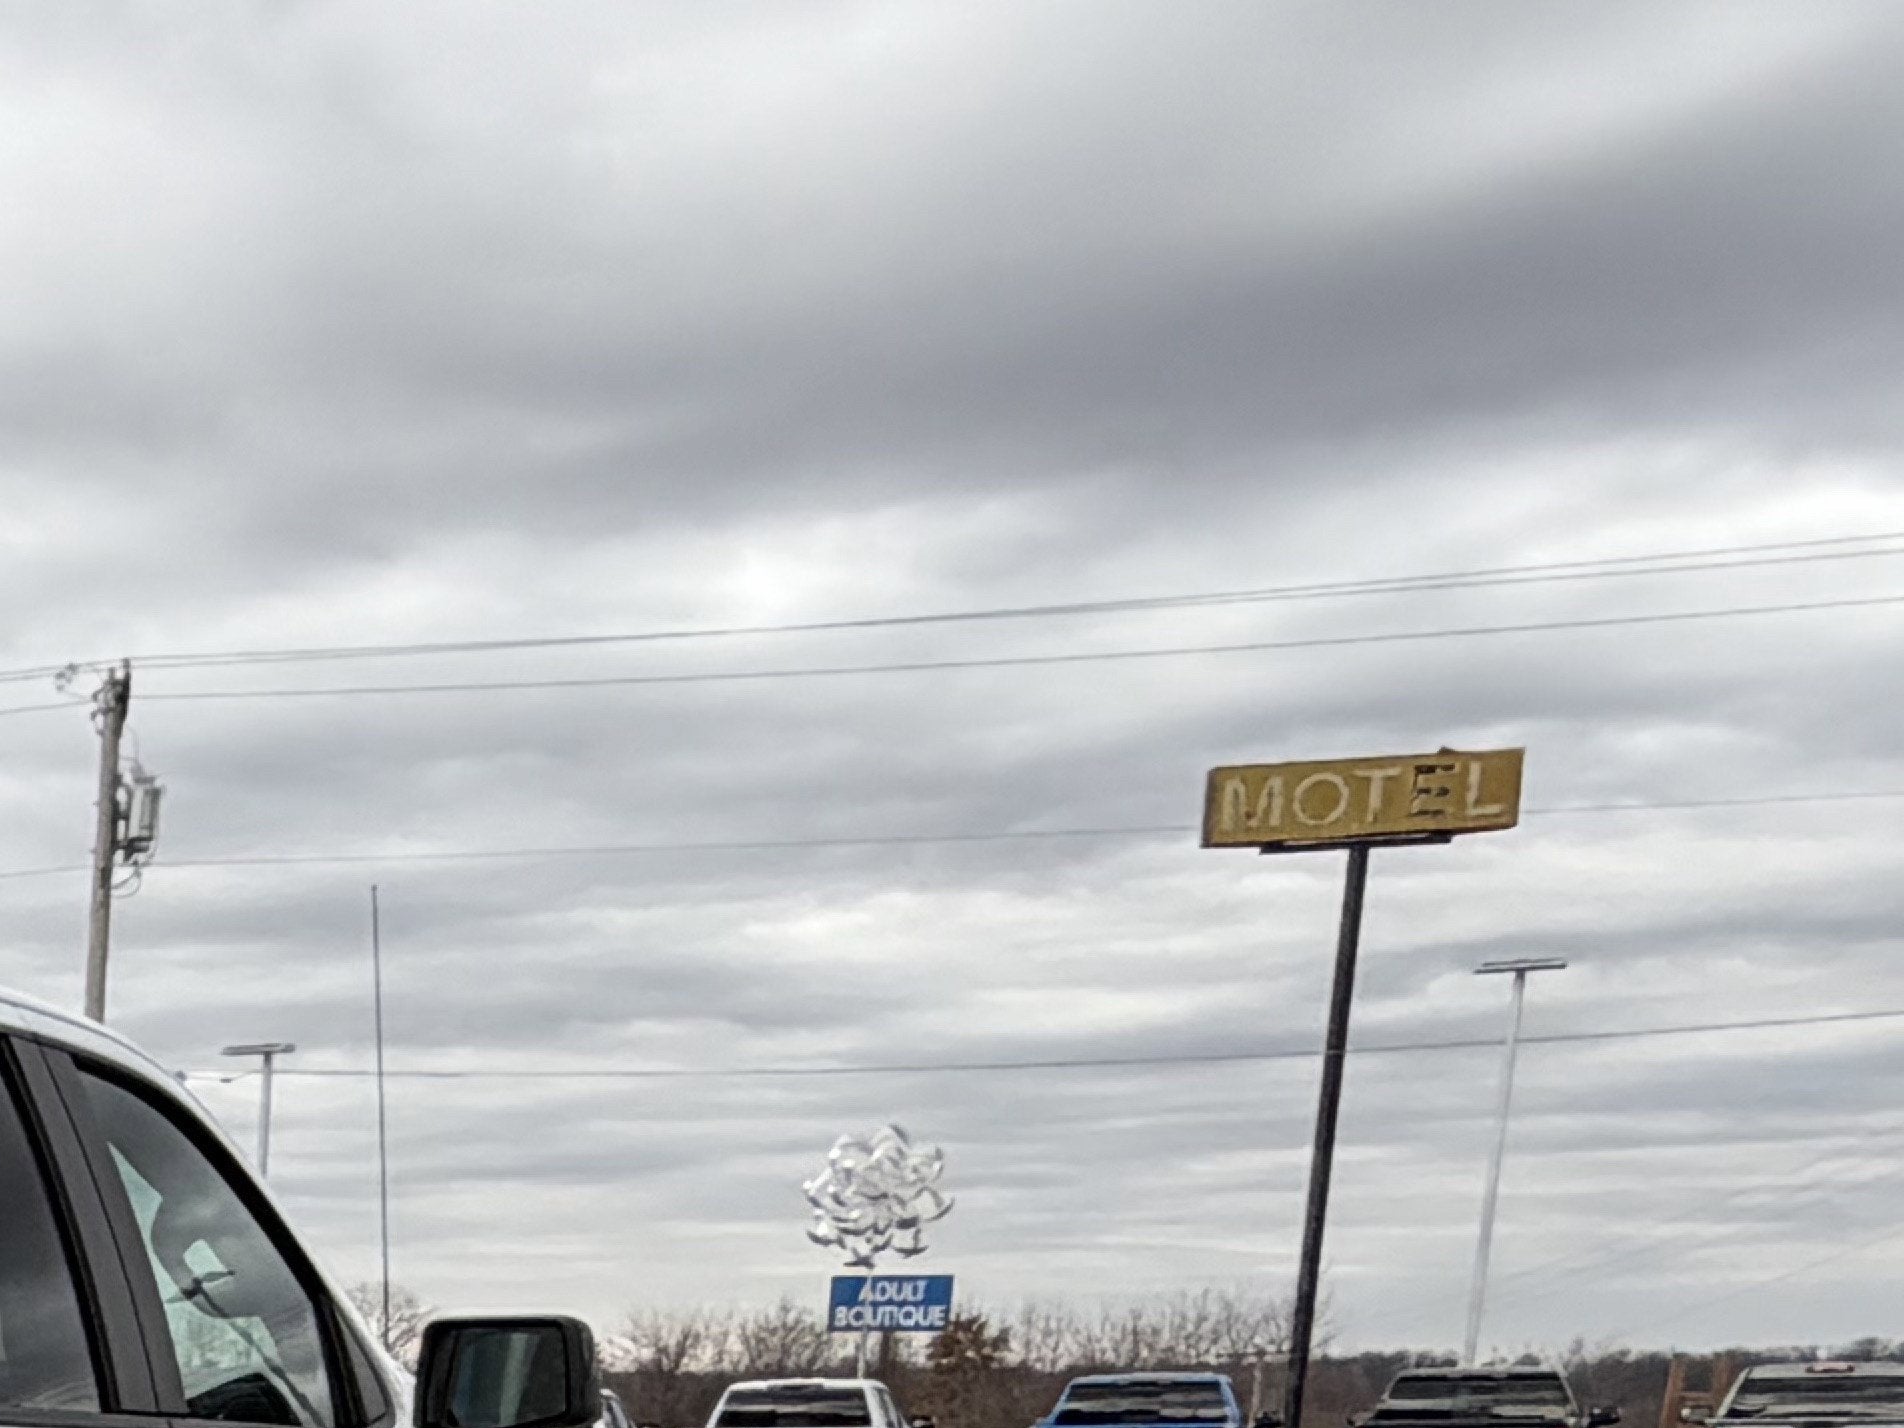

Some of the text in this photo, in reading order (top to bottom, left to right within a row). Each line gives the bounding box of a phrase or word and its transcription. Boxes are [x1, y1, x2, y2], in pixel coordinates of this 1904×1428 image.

[1221, 760, 1504, 833] MOTEL
[857, 1279, 929, 1302] ADULT
[834, 1304, 948, 1327] BOUTIQUE
